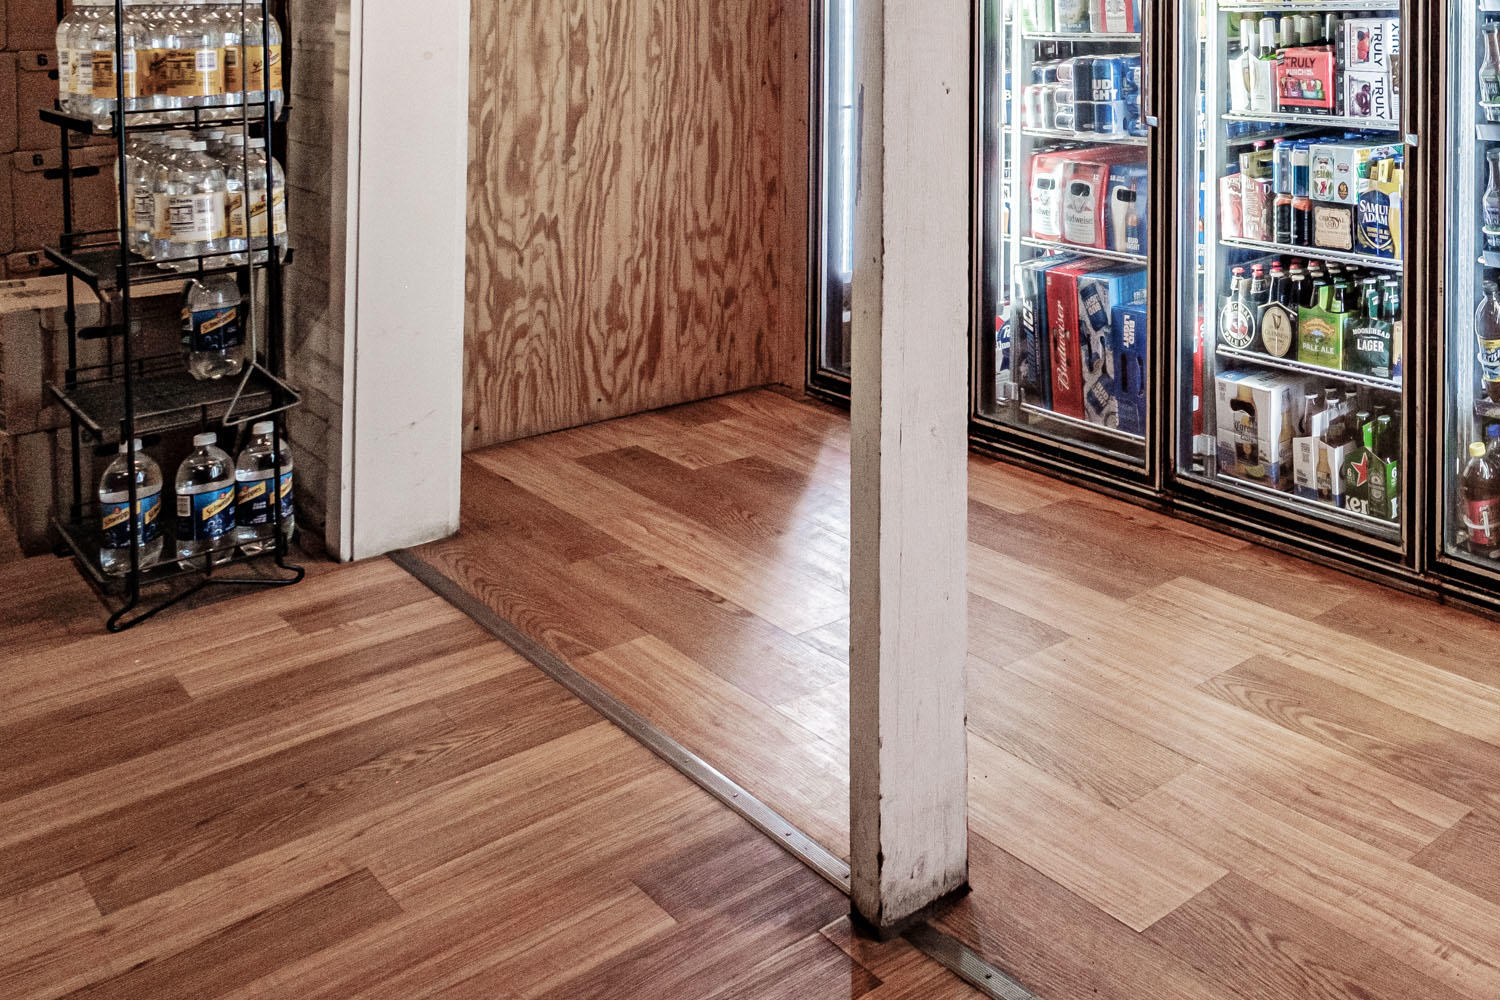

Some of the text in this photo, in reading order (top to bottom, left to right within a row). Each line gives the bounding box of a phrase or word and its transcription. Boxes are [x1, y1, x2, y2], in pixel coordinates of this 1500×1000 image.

[1374, 23, 1383, 67] TRULY
[1285, 55, 1316, 69] TRULY
[1375, 77, 1385, 120] TRULY
[1360, 199, 1388, 214] SAMU
[1362, 211, 1388, 226] ADAM
[1023, 300, 1034, 332] ICE
[1128, 319, 1136, 345] BUD
[1352, 327, 1391, 339] MOOSEHEAD
[1055, 300, 1070, 391] Budweiser
[1302, 342, 1335, 355] PALE ALE
[1356, 339, 1385, 353] LAGER
